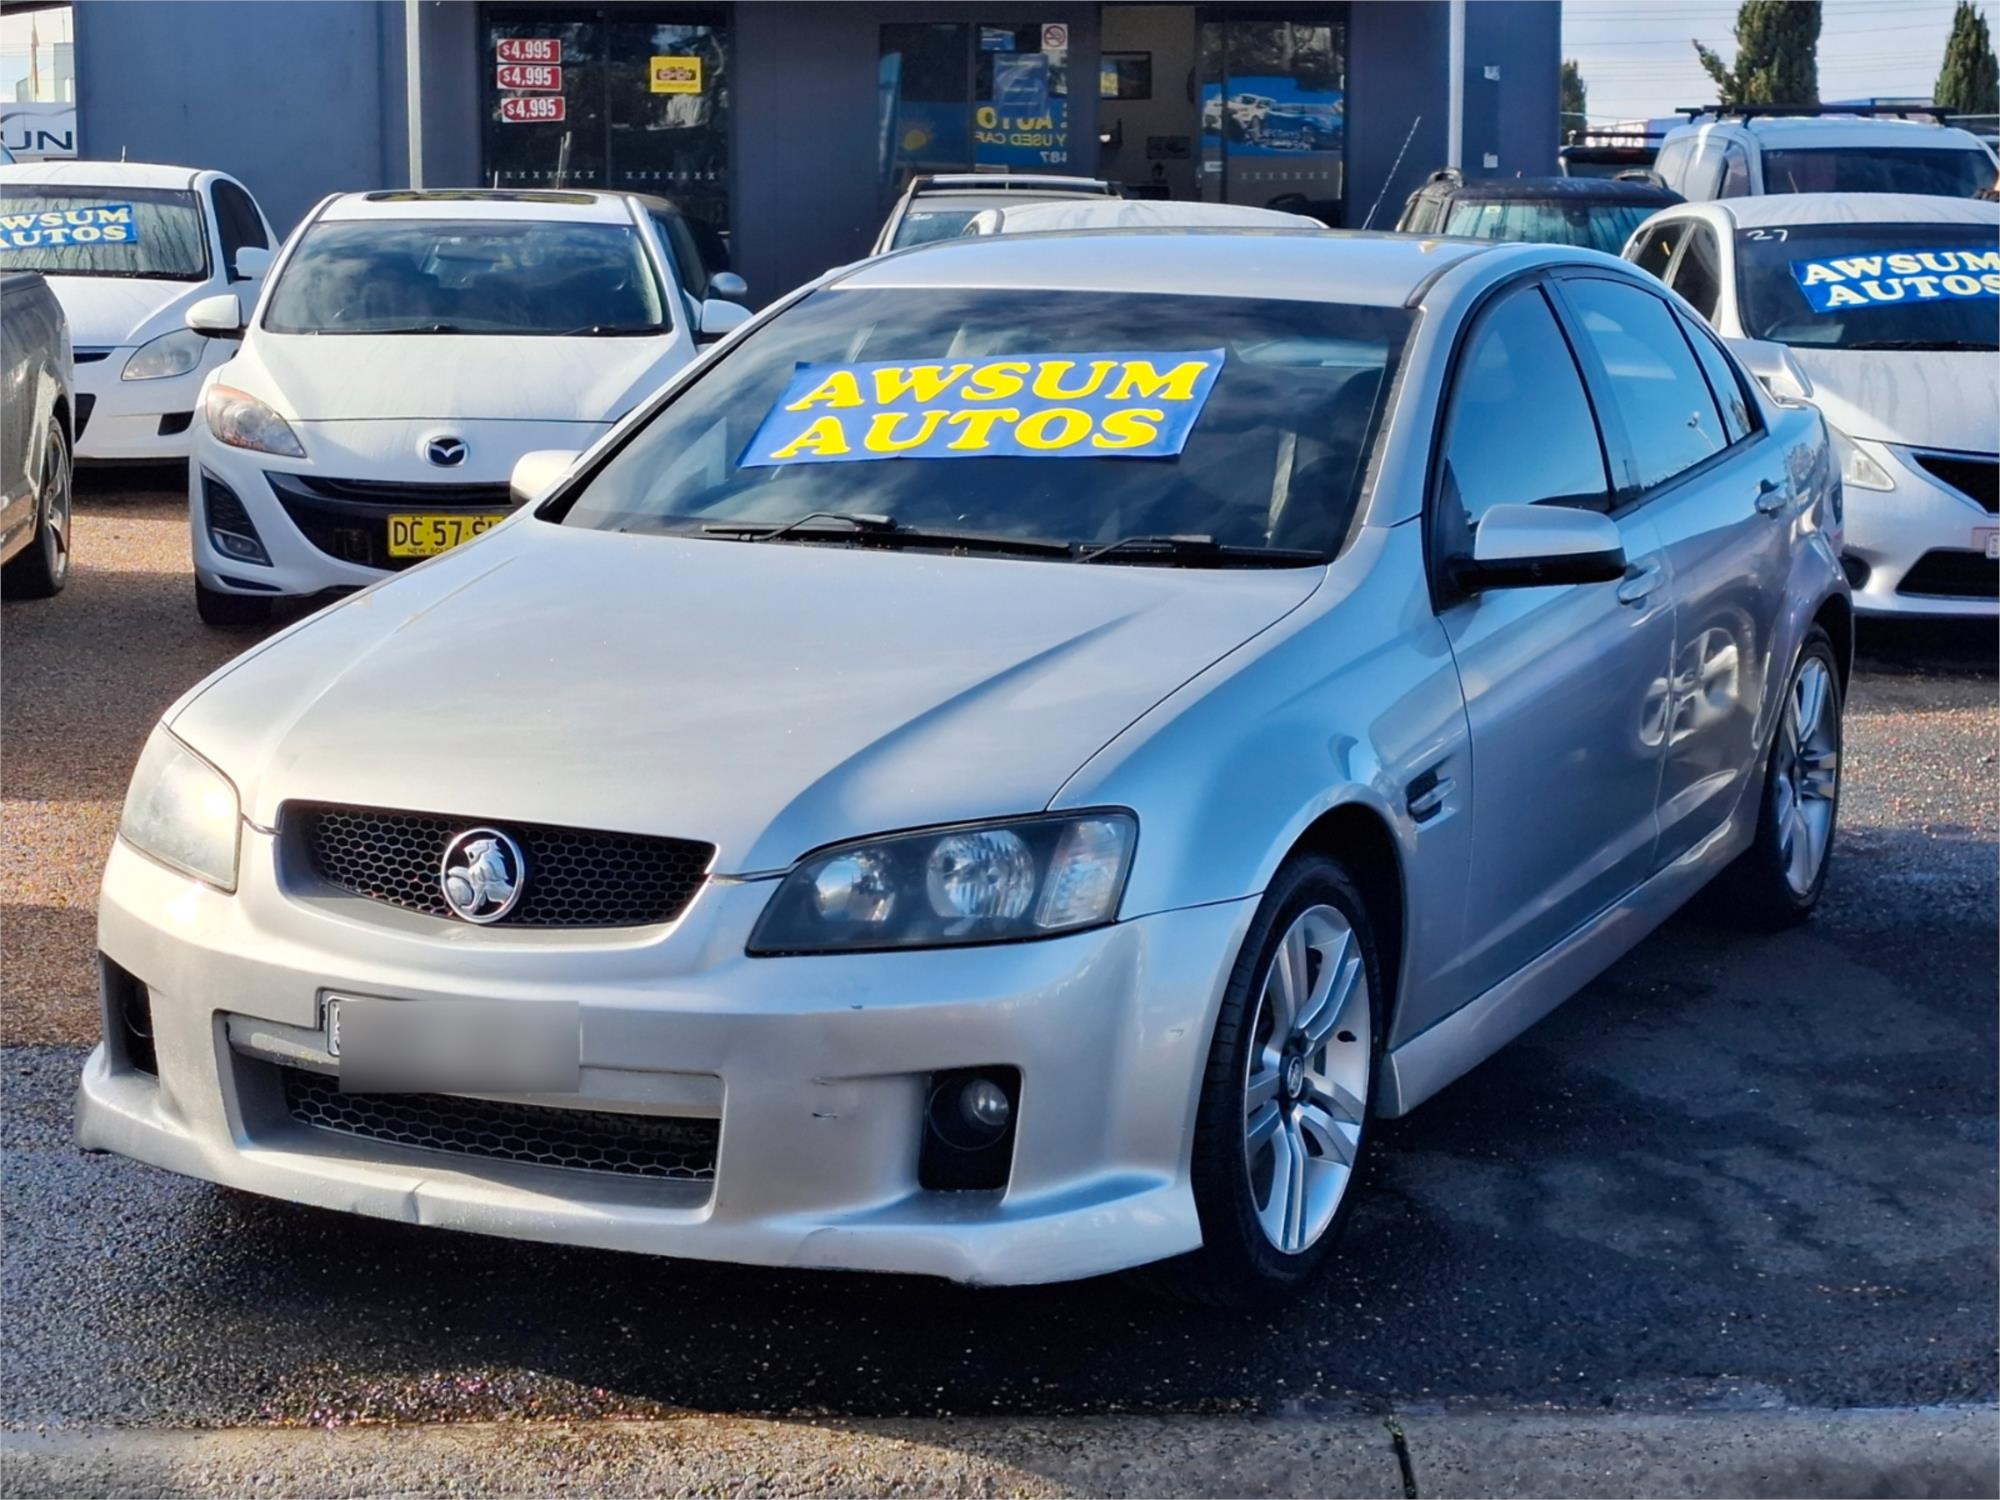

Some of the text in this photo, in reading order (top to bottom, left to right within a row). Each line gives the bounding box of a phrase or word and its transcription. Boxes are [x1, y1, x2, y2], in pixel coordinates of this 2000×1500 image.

[502, 41, 551, 59] $4,995
[502, 67, 552, 86] $4,995
[506, 98, 556, 118] $4,995
[1, 207, 130, 231] WSUM
[1747, 229, 1788, 242] 27
[785, 360, 1209, 411] AWSUM
[771, 408, 1165, 458] AUTOS
[393, 520, 423, 546] DC
